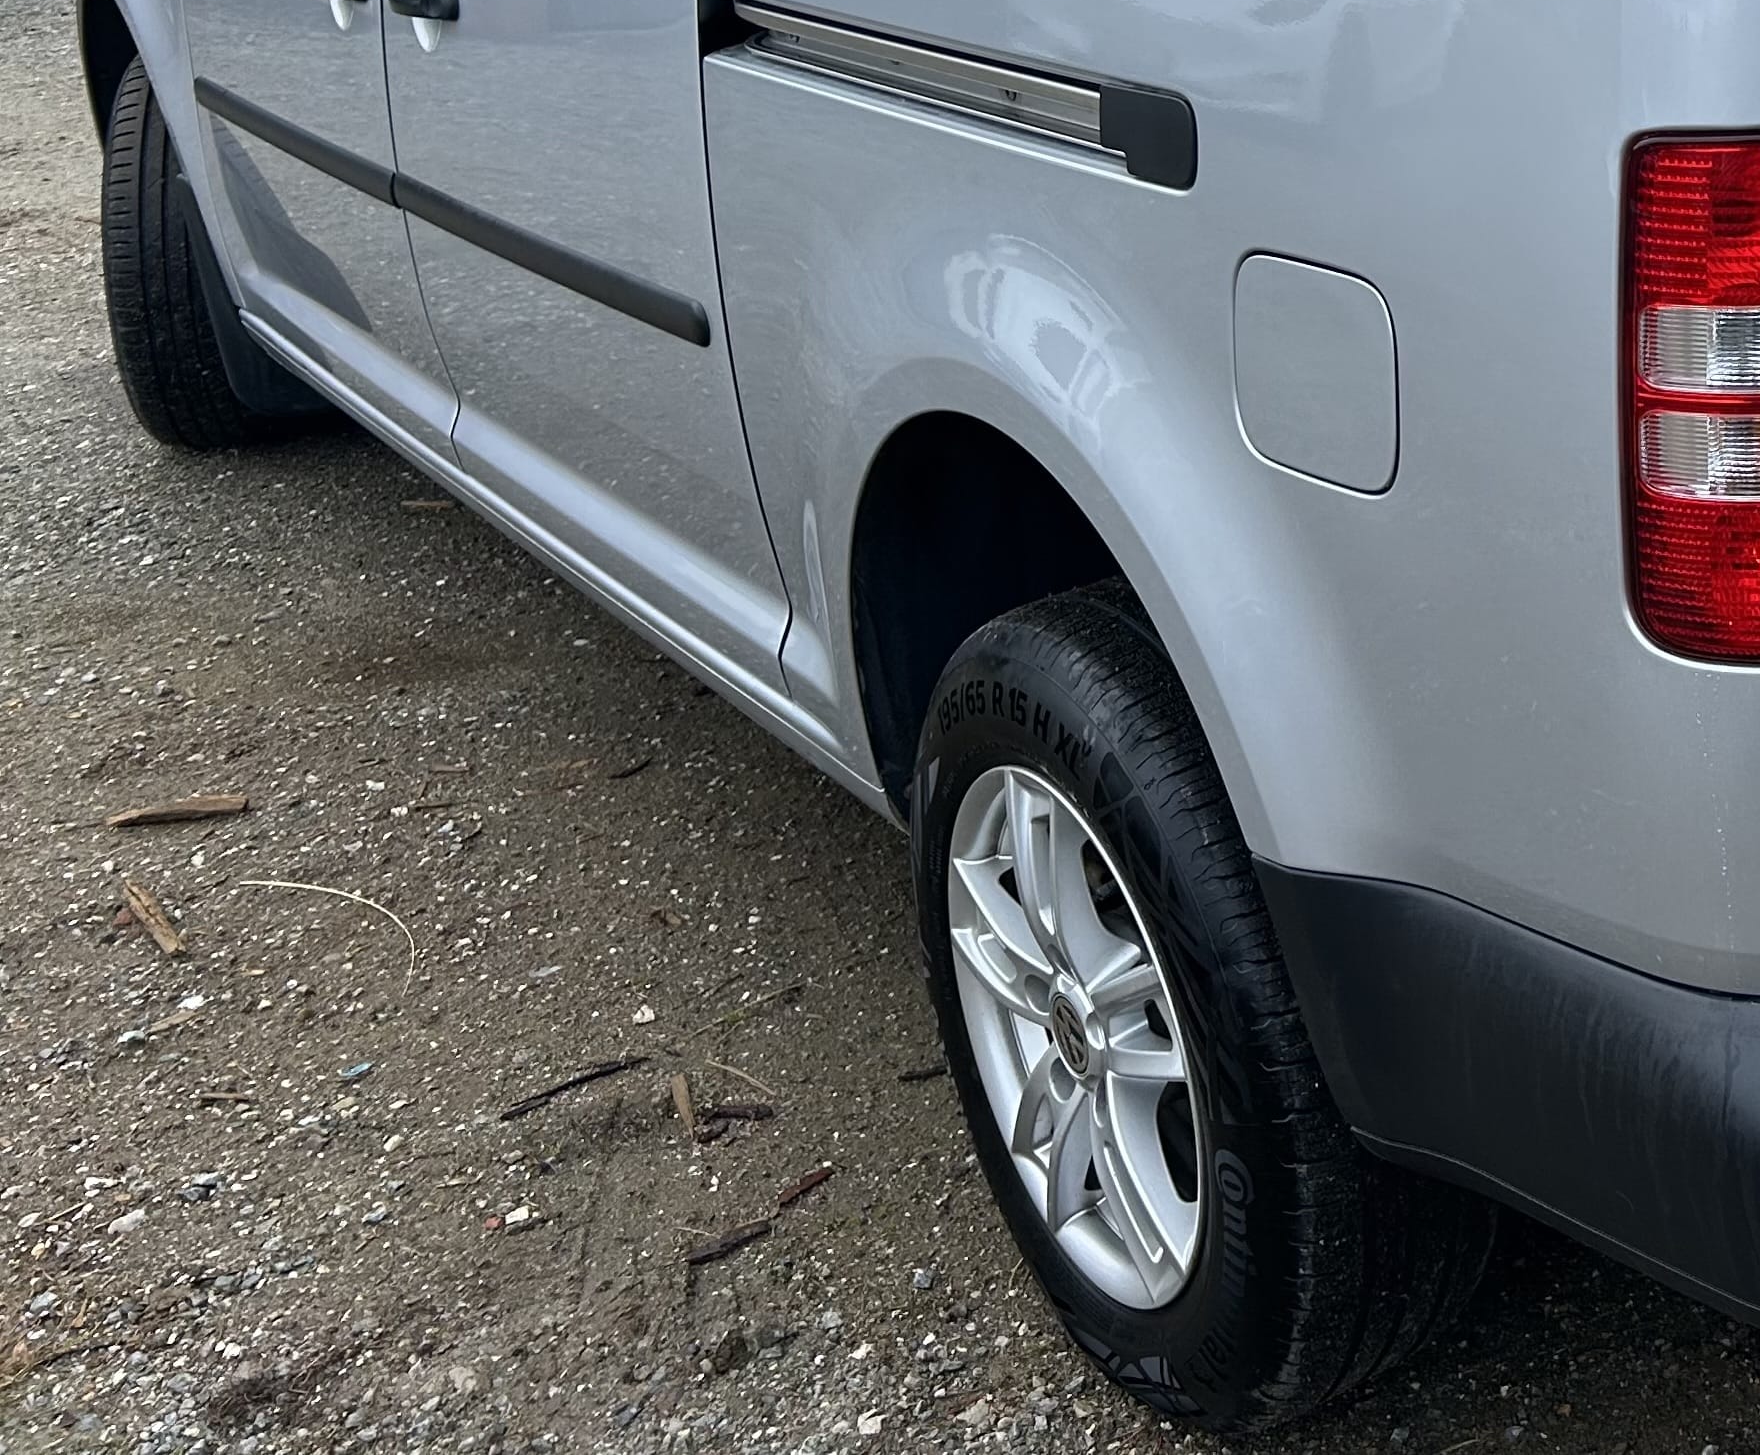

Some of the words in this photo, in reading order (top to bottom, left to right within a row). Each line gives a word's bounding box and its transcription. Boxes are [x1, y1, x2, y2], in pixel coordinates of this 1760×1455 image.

[937, 679, 986, 736] 195/65
[991, 680, 1006, 718] R
[1008, 687, 1029, 728] 15
[1032, 701, 1052, 745] H
[1054, 721, 1081, 782] XL
